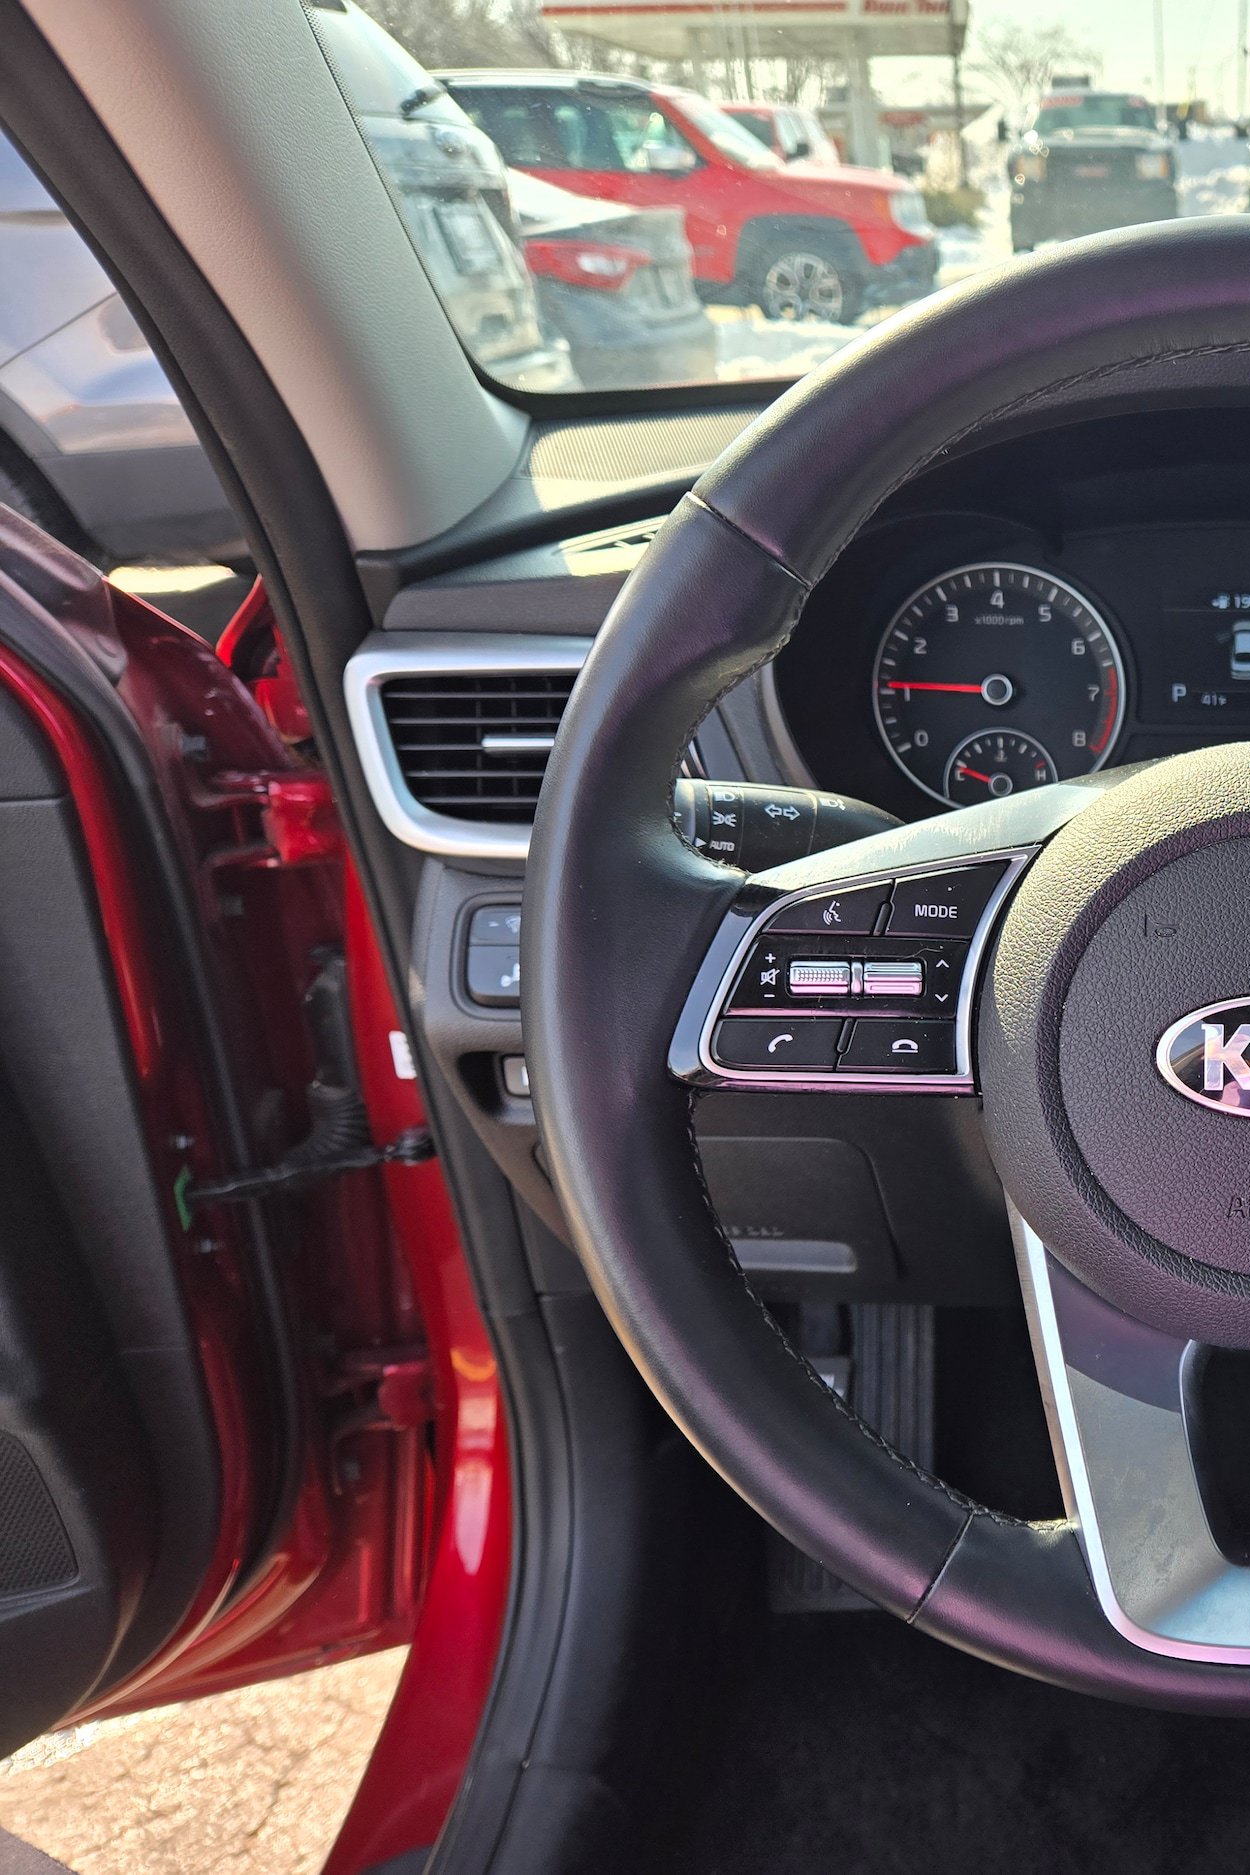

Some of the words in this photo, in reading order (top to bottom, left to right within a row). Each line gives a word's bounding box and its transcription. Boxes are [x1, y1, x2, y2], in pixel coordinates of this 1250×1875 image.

[990, 592, 1004, 608] 4
[946, 605, 959, 622] 3
[1038, 605, 1051, 622] 5
[914, 639, 927, 654] 2
[1072, 640, 1086, 655] 6
[904, 686, 911, 701] 1
[1088, 686, 1100, 701] 7
[1171, 682, 1187, 702] P
[914, 730, 928, 747] 0
[1072, 731, 1086, 747] 8
[1036, 769, 1046, 781] H
[710, 840, 735, 852] AUTO
[914, 904, 958, 919] MODE
